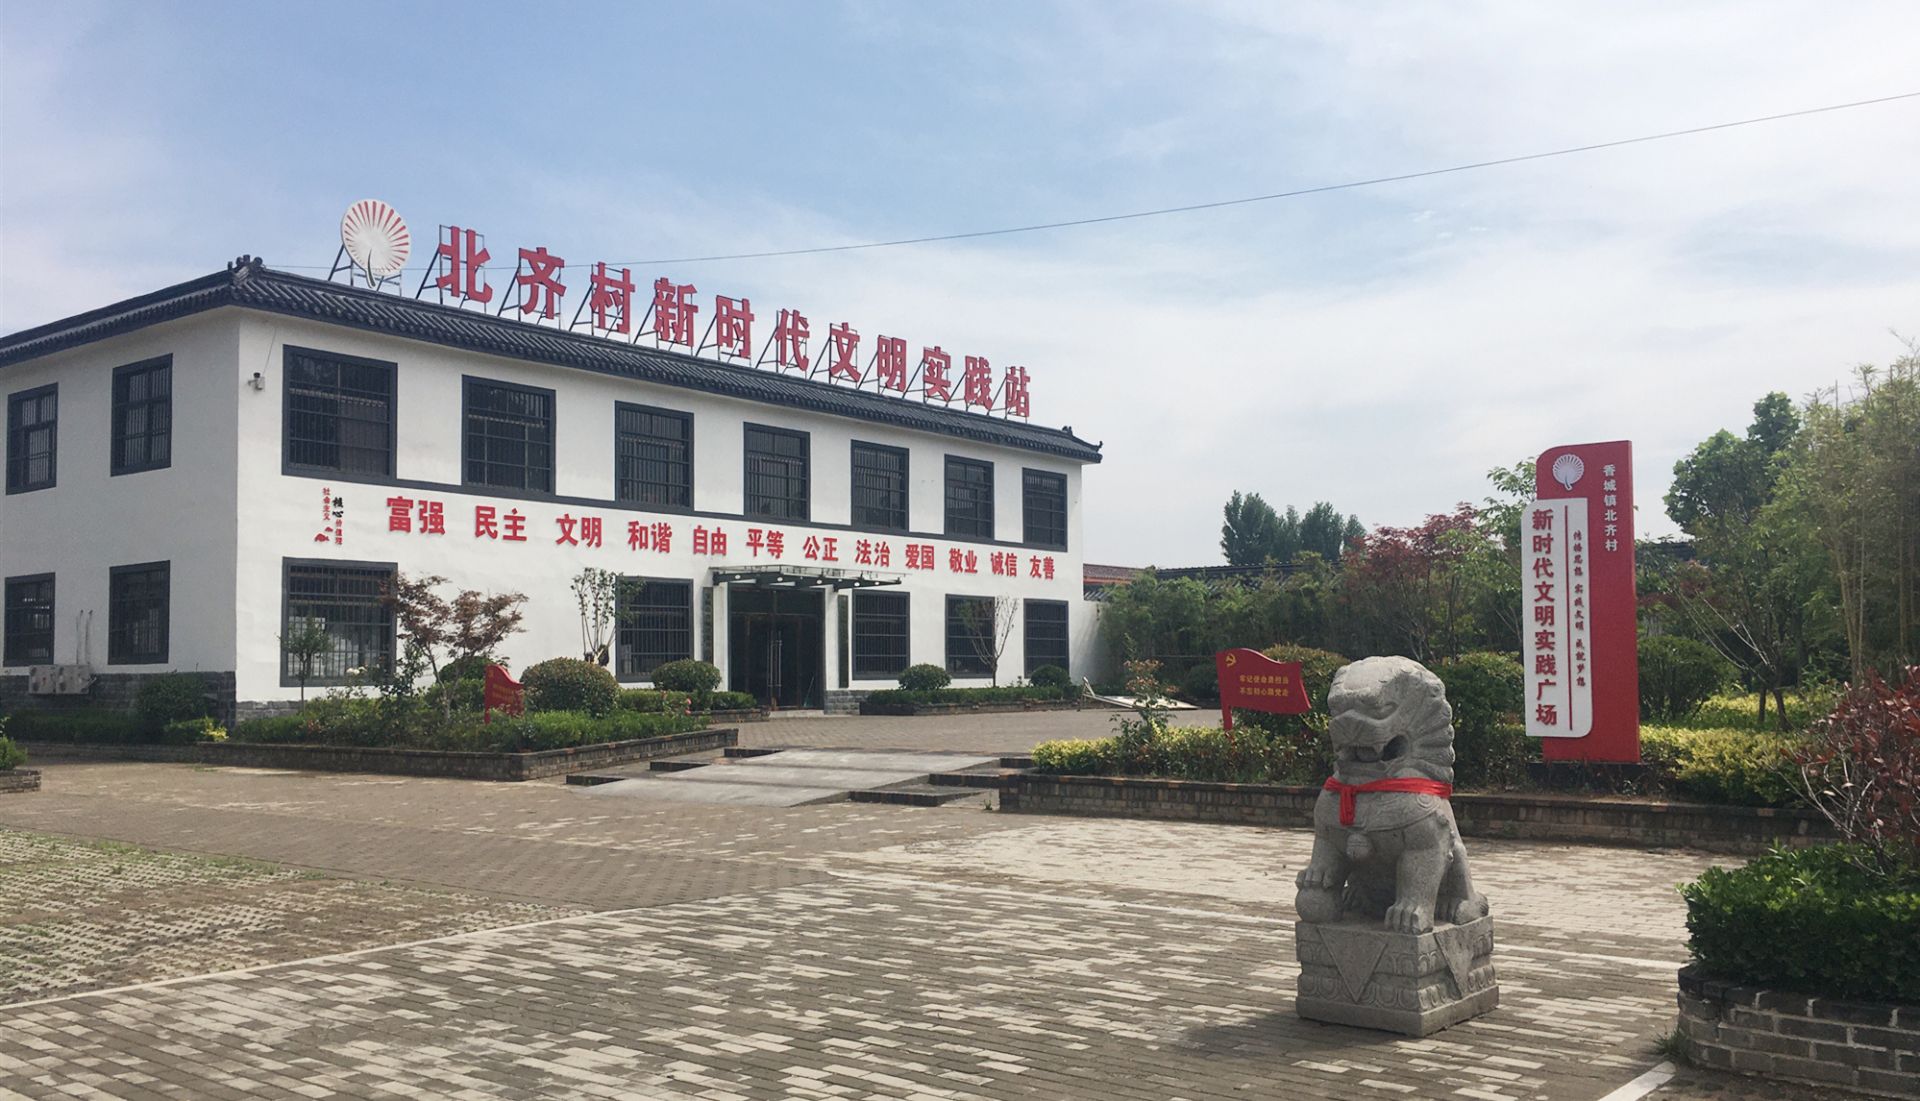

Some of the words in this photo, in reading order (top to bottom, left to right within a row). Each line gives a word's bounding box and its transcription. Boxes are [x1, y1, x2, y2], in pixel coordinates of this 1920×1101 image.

[436, 225, 1031, 418] 北齐村新时代文明实践站
[322, 487, 331, 520] 社会主义
[387, 496, 446, 535] 富强
[475, 505, 527, 541] 民主
[556, 513, 602, 548] 文明
[628, 520, 672, 553] 和谐
[693, 525, 727, 555] 自由
[747, 528, 784, 558] 平等
[803, 536, 838, 561] 公正
[856, 539, 890, 567] 法治
[906, 544, 934, 570] 爱国
[949, 548, 977, 573] 敬业
[991, 552, 1017, 577] 诚信
[1030, 555, 1055, 579] 友善
[1603, 464, 1618, 552] 香城镇北齐村
[1532, 509, 1557, 726] 新时代文明实践广场
